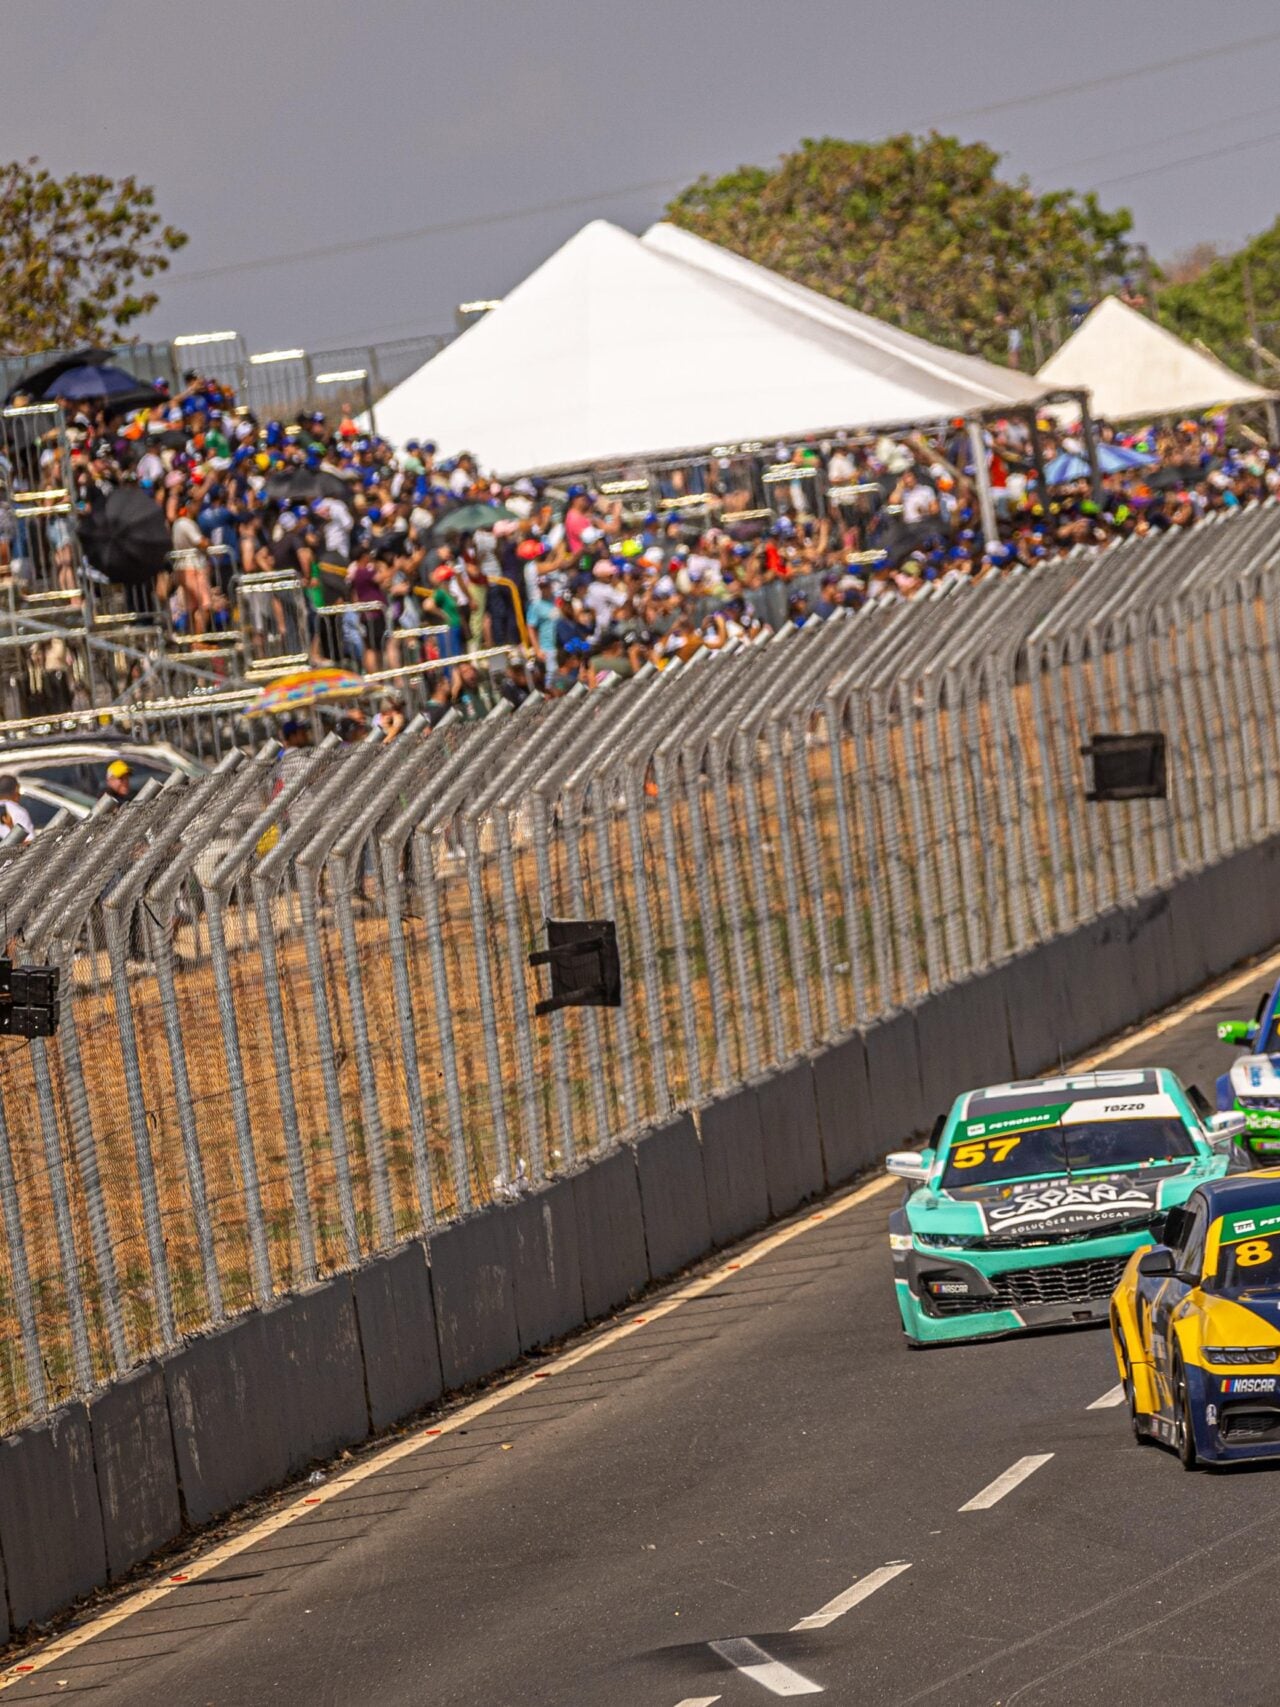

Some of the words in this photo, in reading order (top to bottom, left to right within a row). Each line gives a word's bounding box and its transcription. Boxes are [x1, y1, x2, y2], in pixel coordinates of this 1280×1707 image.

[1103, 1103, 1145, 1113] TOZZO
[952, 1137, 1021, 1169] 57
[1235, 1241, 1273, 1267] 8
[1233, 1379, 1276, 1392] NASCAR
